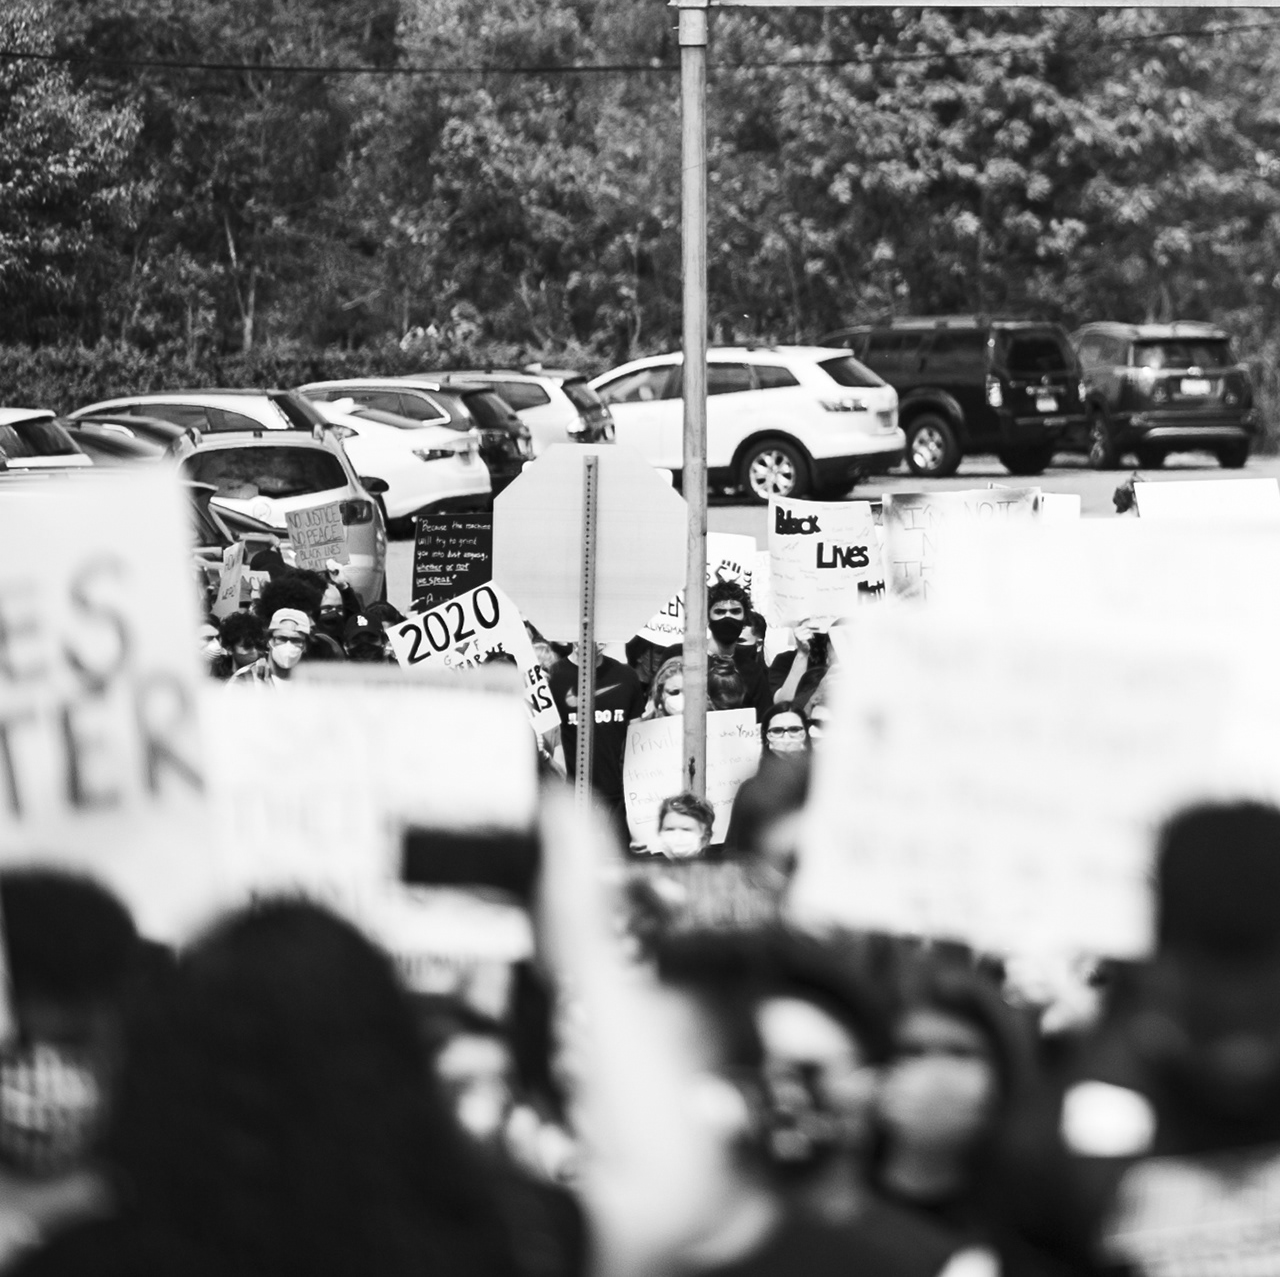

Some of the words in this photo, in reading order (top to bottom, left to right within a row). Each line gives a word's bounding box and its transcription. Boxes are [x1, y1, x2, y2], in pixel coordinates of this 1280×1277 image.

[288, 513, 303, 529] NO
[305, 503, 341, 526] JUSTICE
[291, 530, 307, 547] NO
[306, 523, 338, 547] PEACE
[299, 547, 322, 562] BLACK
[398, 585, 500, 667] 2020
